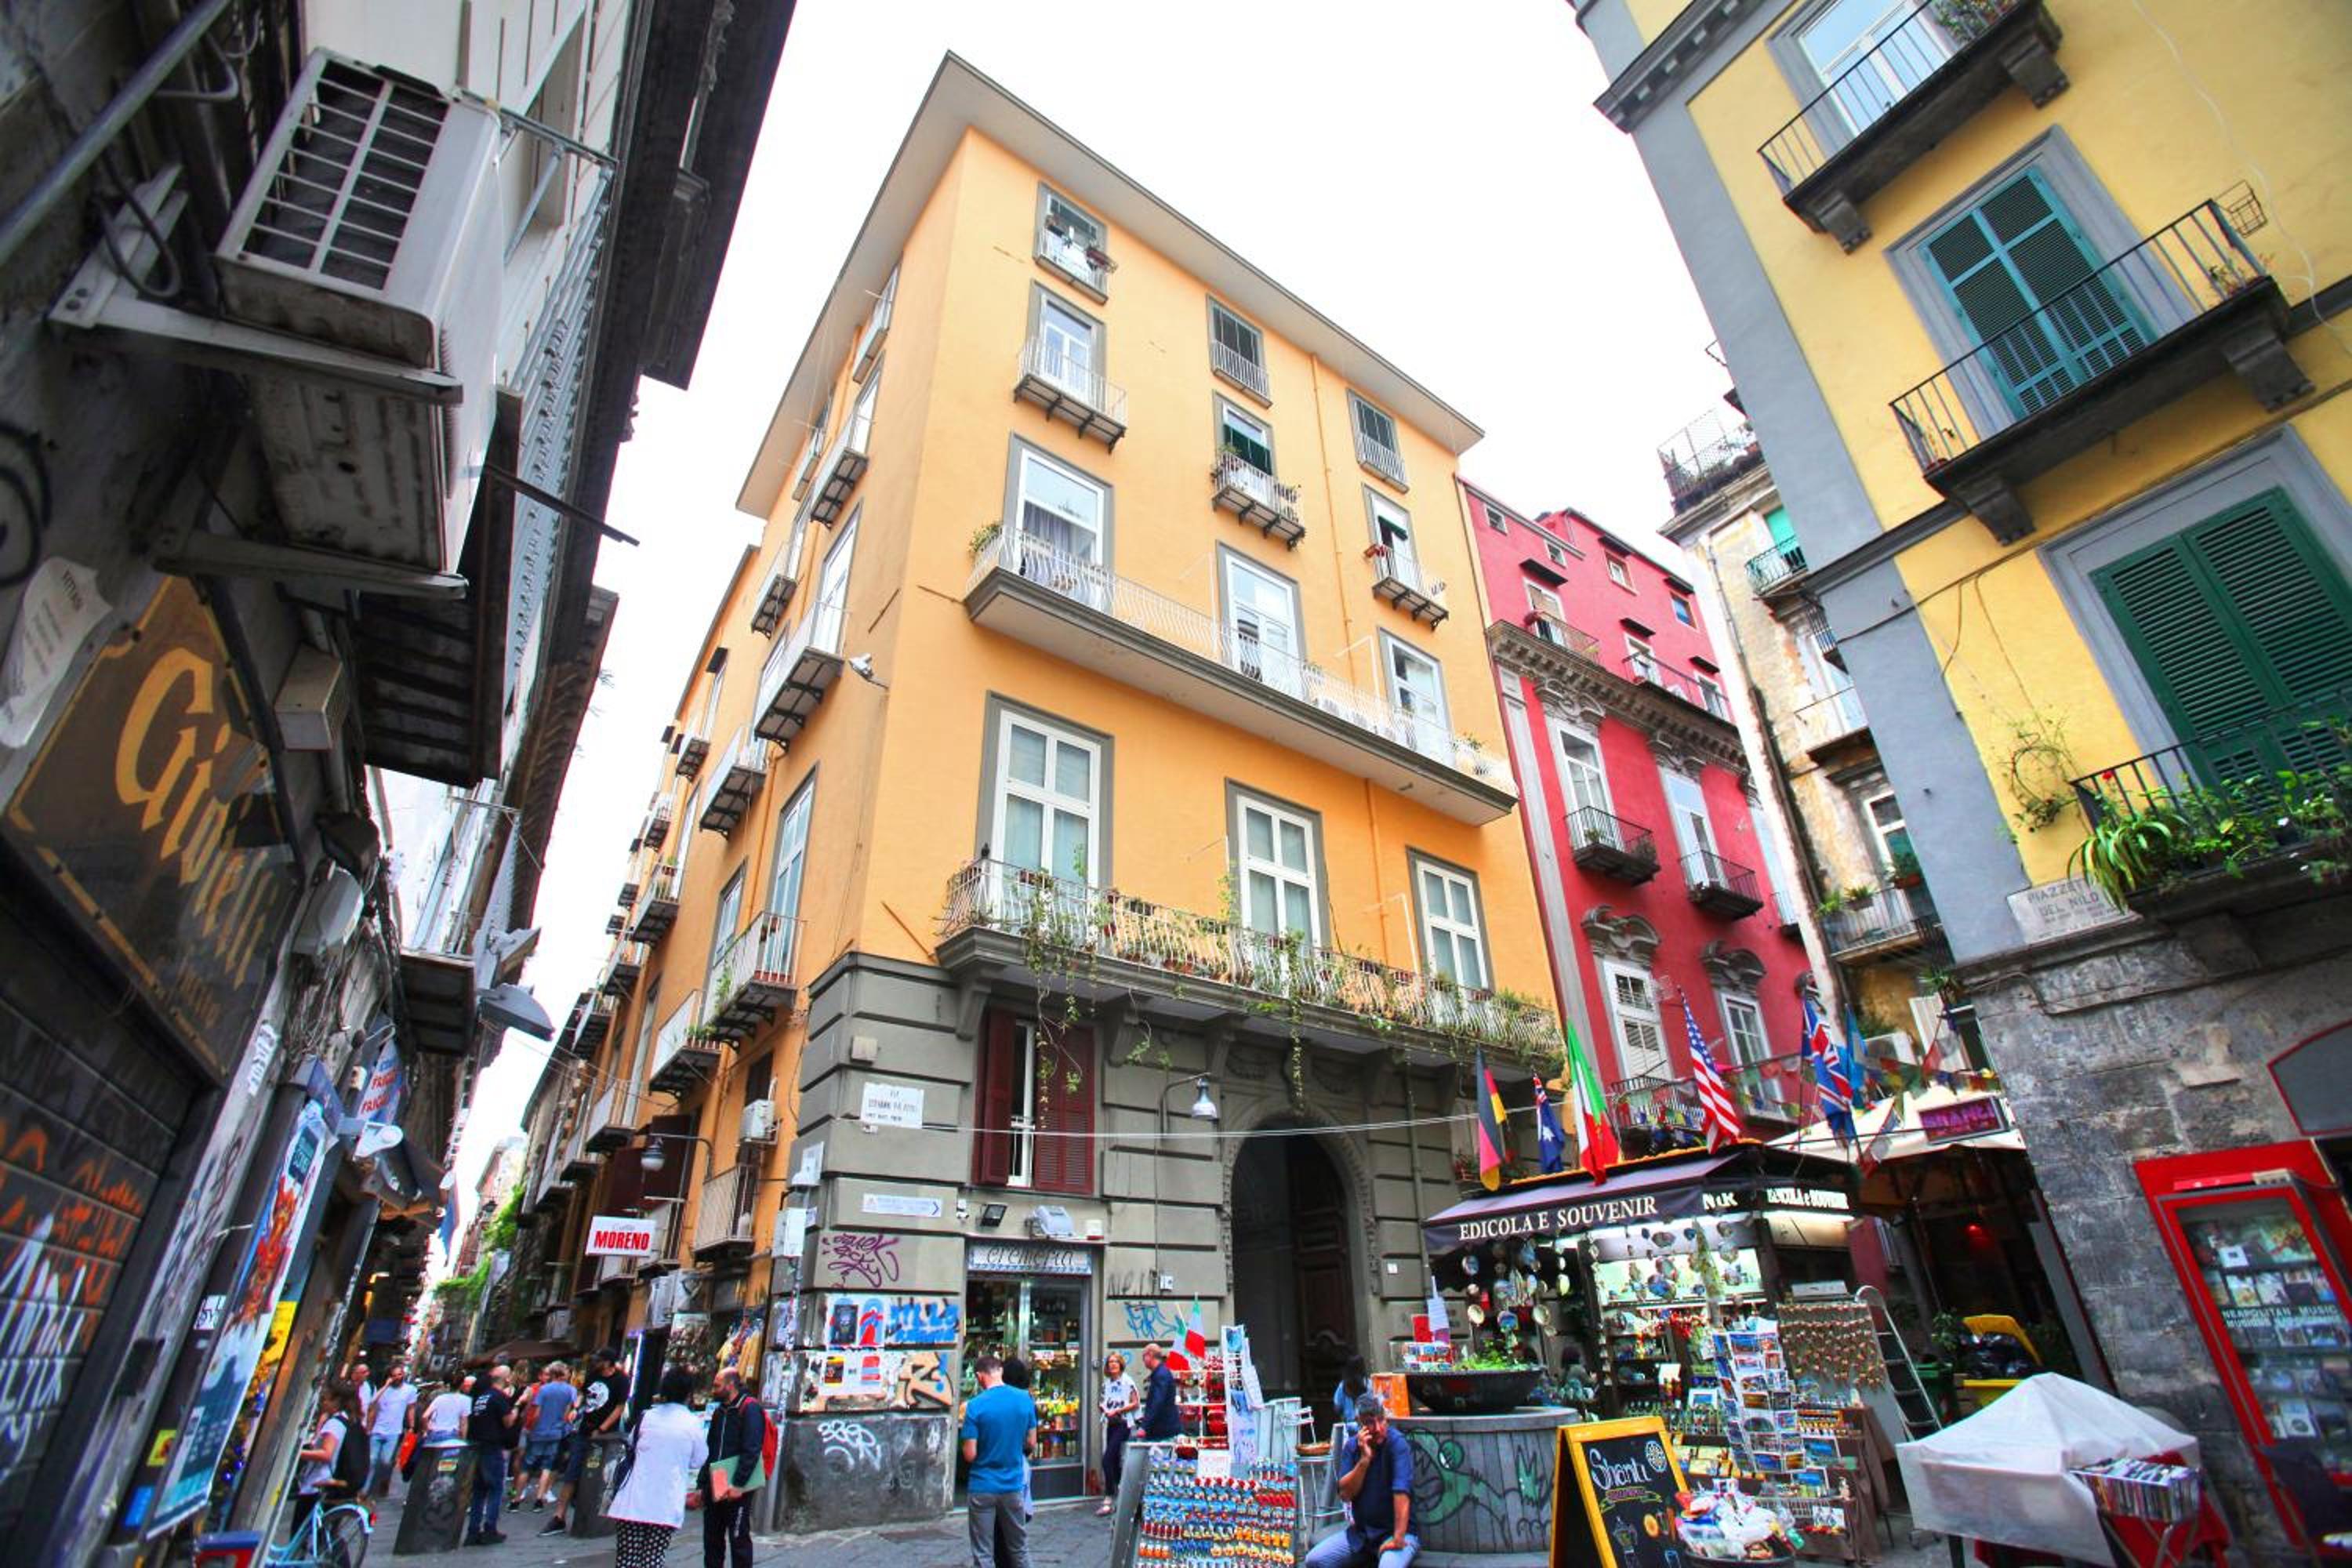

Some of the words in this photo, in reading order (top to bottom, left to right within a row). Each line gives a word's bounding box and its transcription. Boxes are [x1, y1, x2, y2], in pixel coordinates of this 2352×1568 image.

[1459, 1215, 1533, 1241] EDICOLA
[1538, 1211, 1549, 1230] E
[1557, 1196, 1658, 1228] SOUVENIR
[593, 1230, 650, 1250] MORENO
